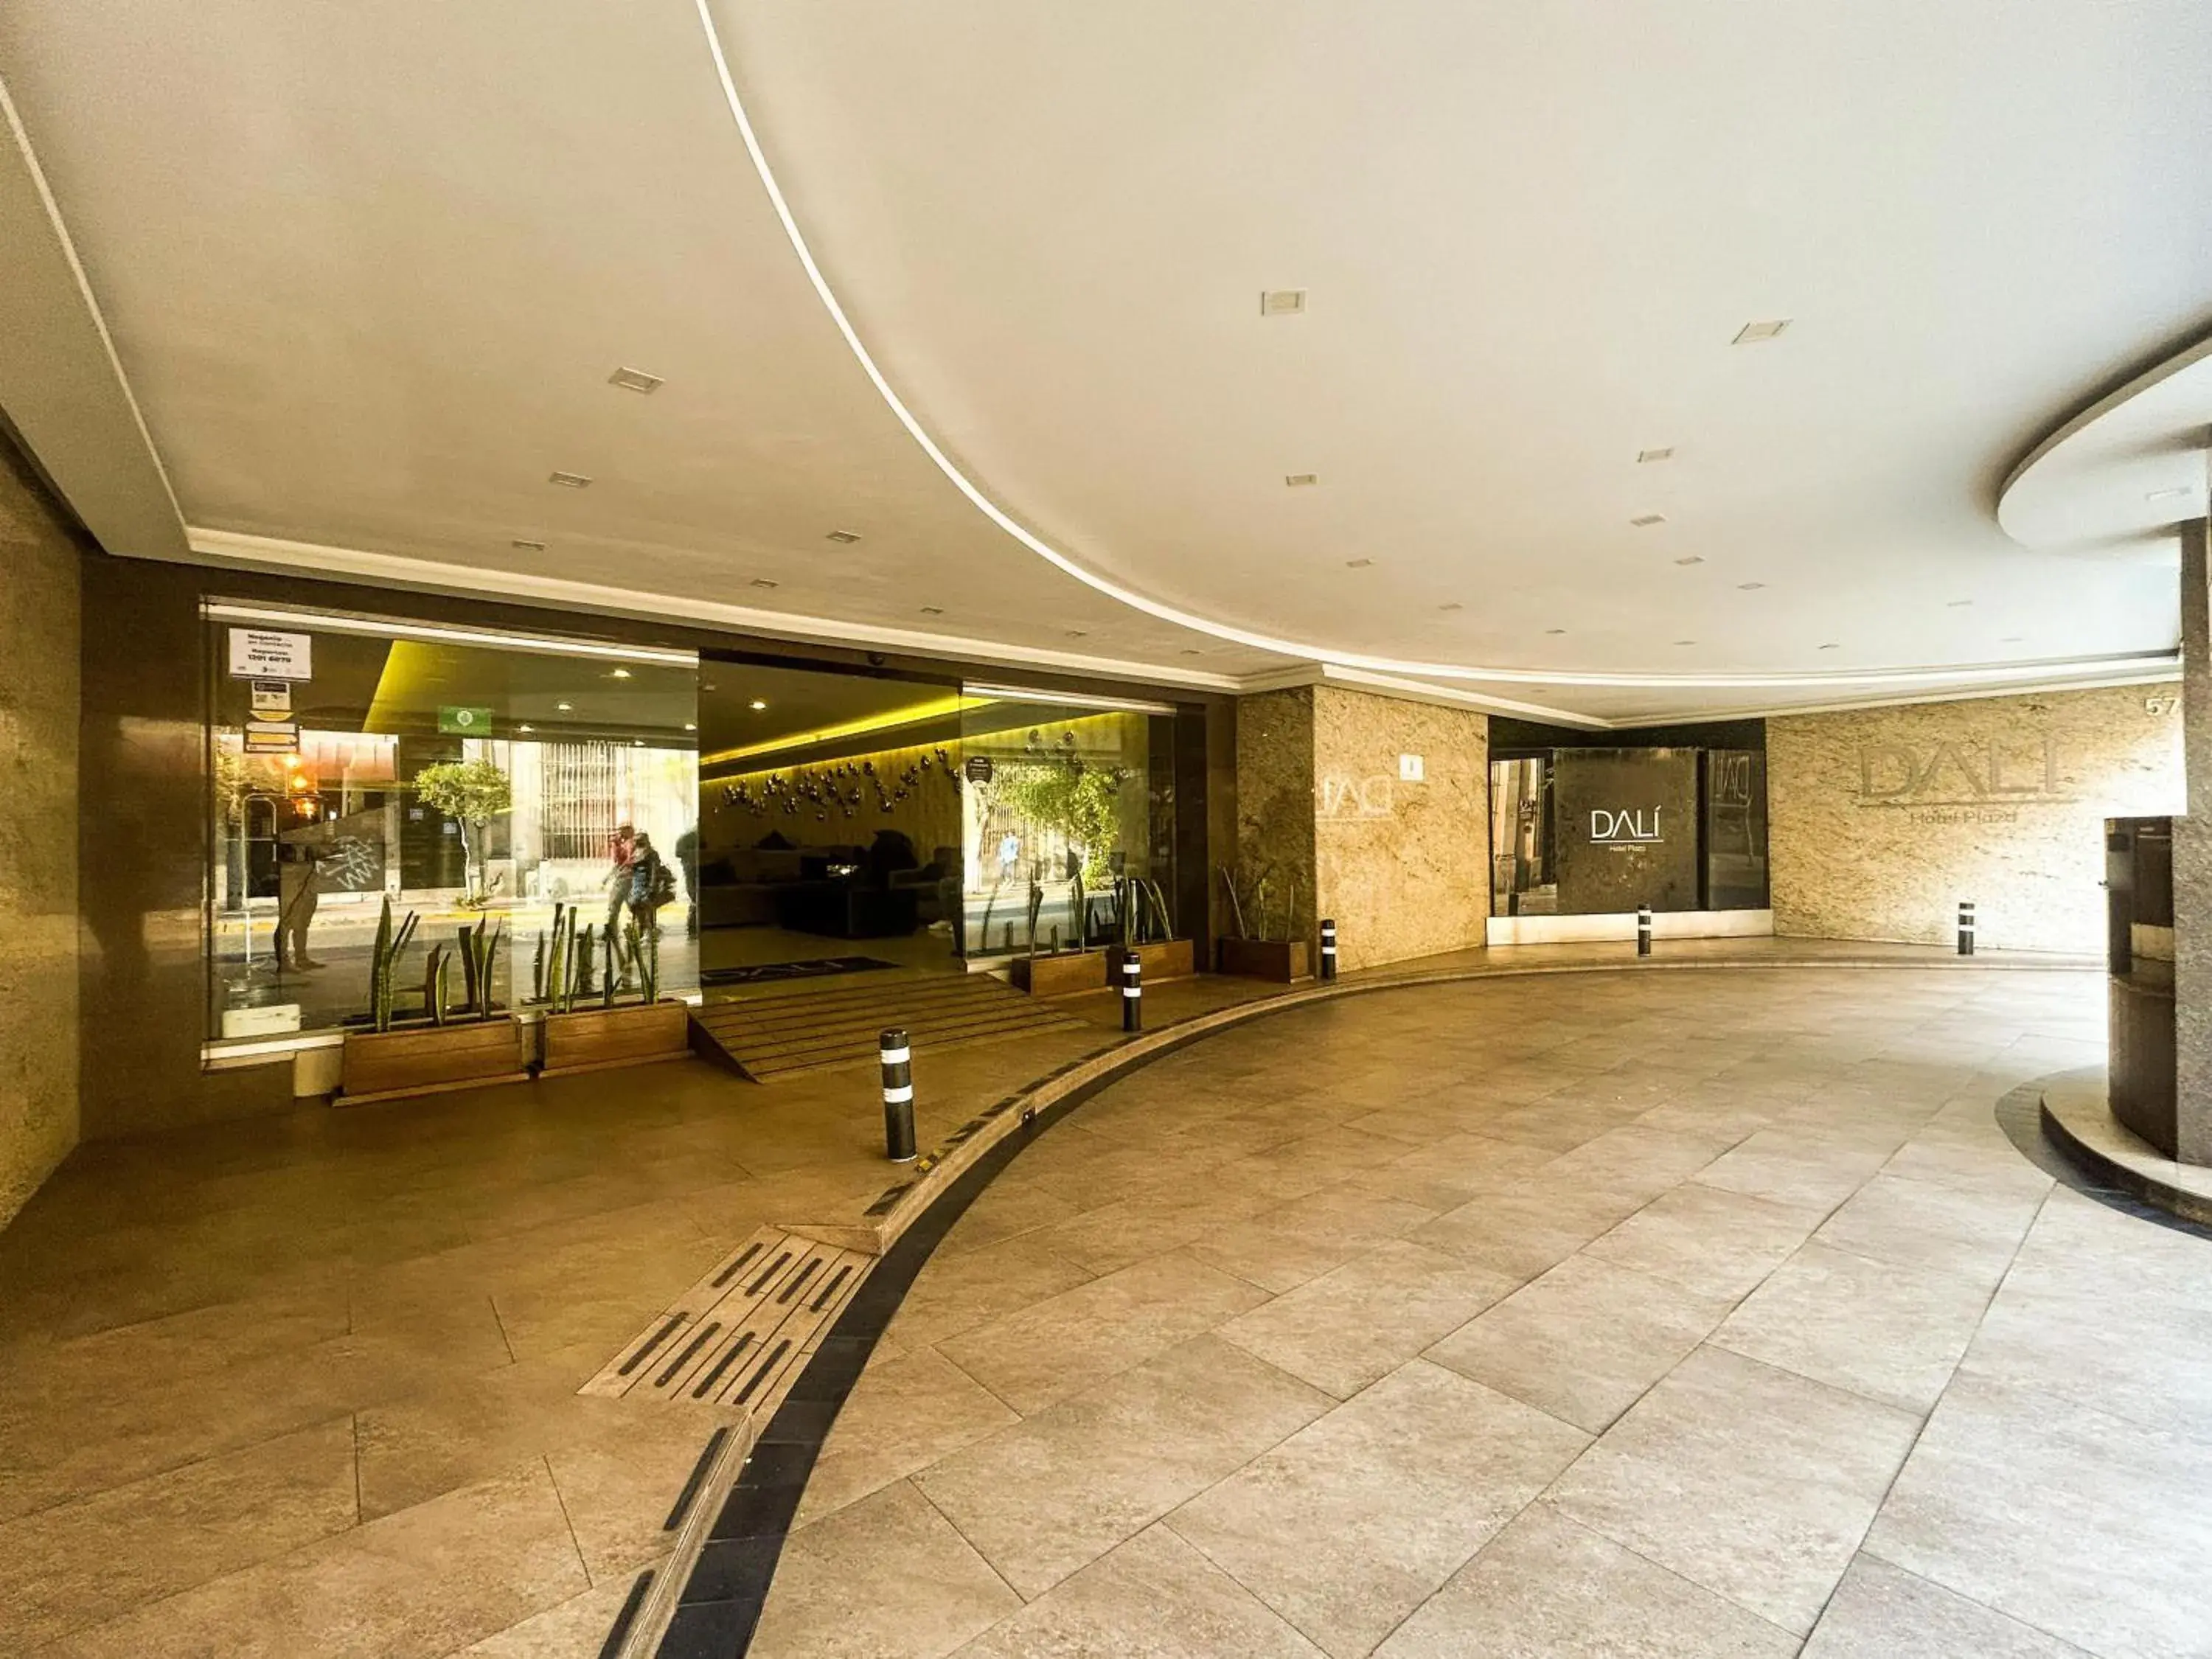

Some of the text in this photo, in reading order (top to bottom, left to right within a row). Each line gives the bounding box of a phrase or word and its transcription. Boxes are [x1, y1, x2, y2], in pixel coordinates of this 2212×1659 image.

[2144, 696, 2182, 716] 57
[1591, 804, 1662, 838] DALÍ
[1964, 811, 2017, 824] Plaza
